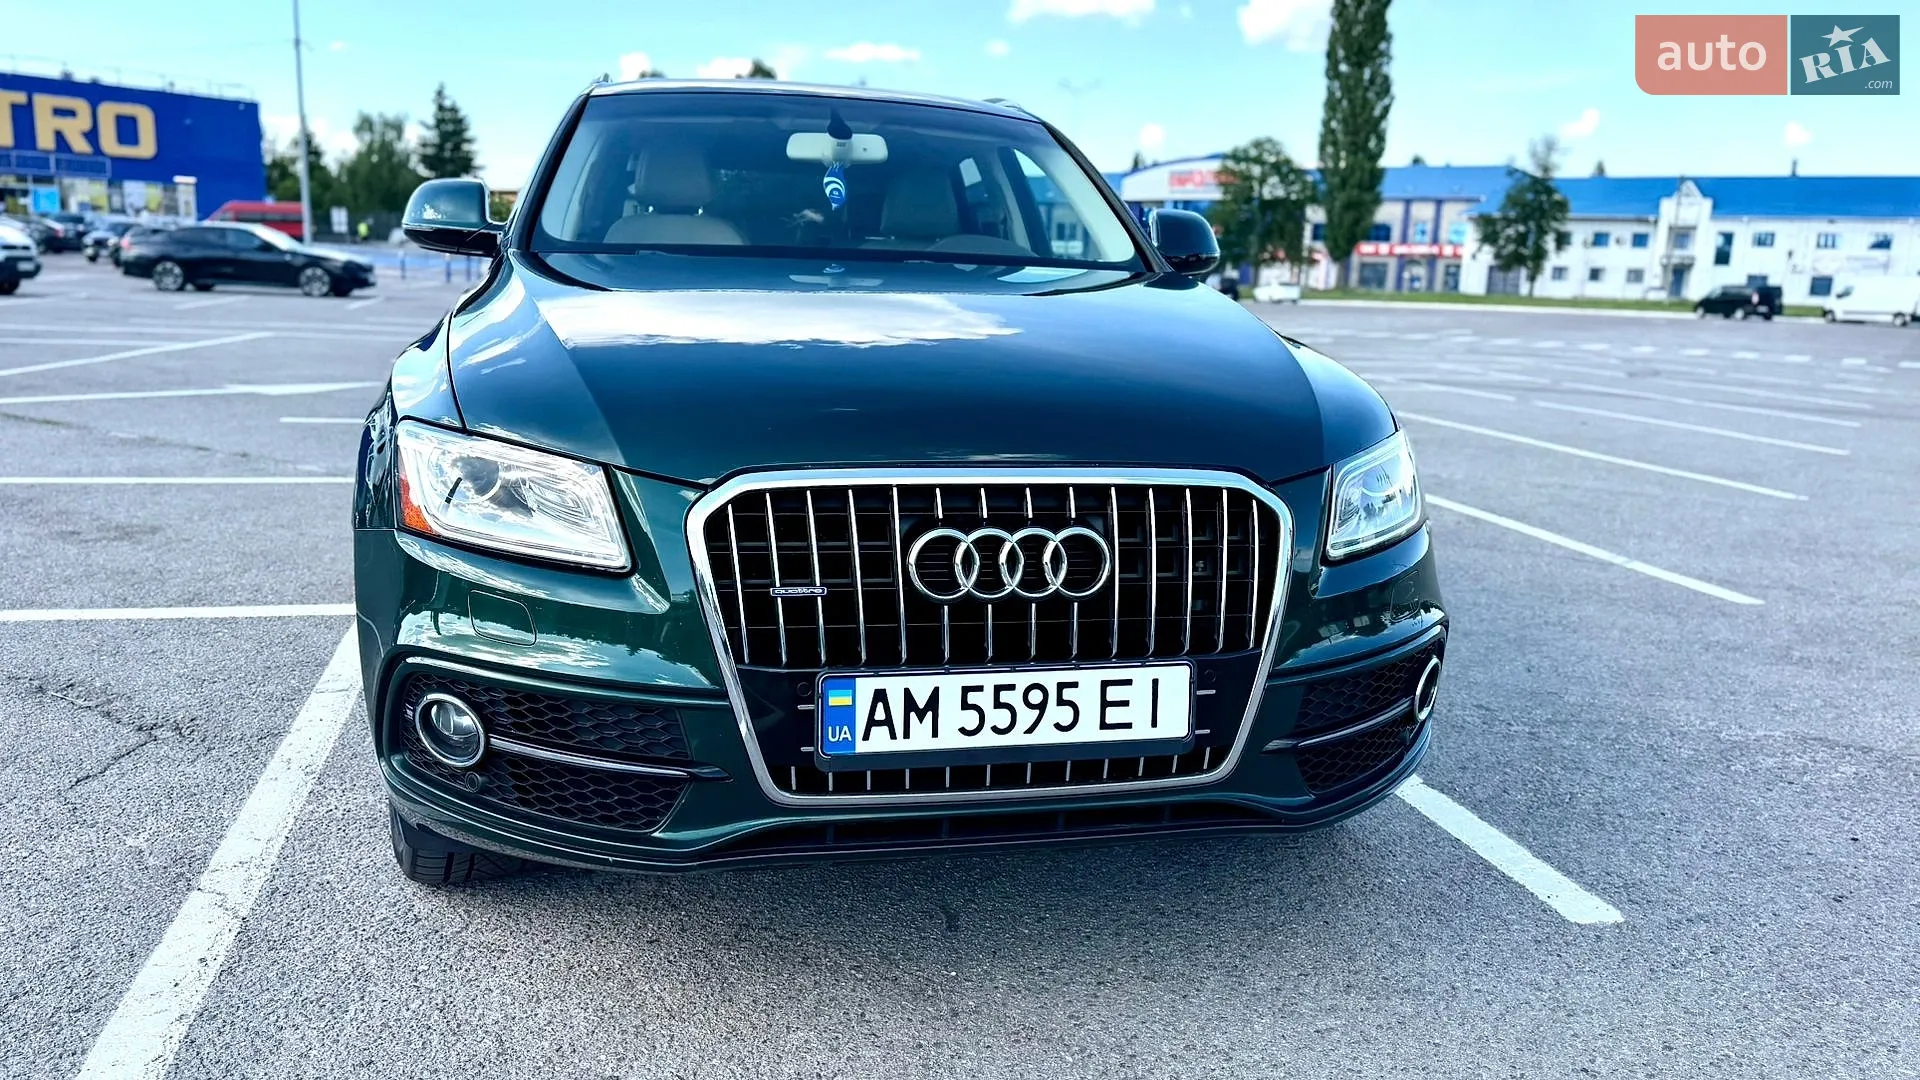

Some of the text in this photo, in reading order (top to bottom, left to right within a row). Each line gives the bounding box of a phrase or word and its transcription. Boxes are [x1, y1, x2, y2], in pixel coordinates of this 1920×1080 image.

[862, 678, 1160, 742] AM 5595 EI
[827, 726, 852, 743] UA
